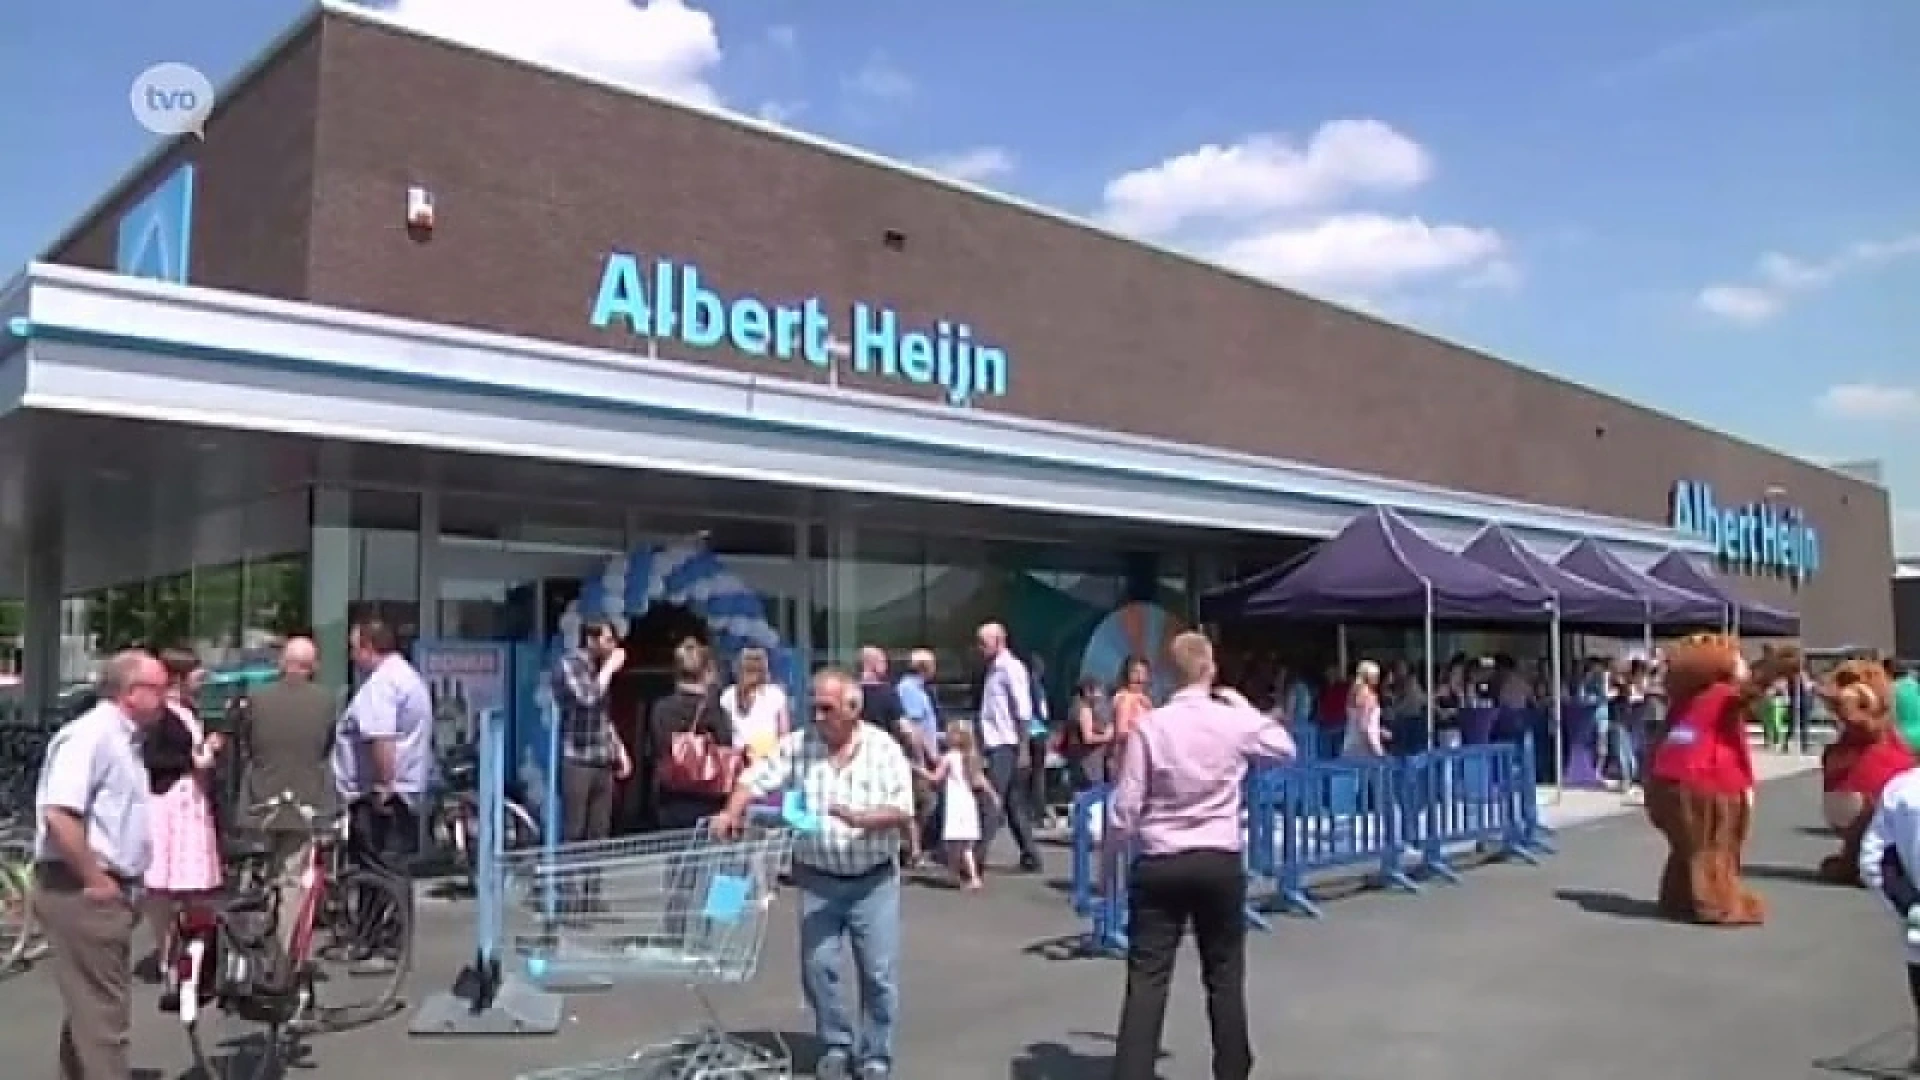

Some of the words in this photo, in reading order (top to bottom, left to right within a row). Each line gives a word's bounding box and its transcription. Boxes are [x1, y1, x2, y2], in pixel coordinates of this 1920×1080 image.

[590, 252, 830, 366] Albert
[851, 302, 1008, 405] Heijn
[1671, 479, 1760, 566] Albert
[1762, 503, 1820, 582] Heijn
